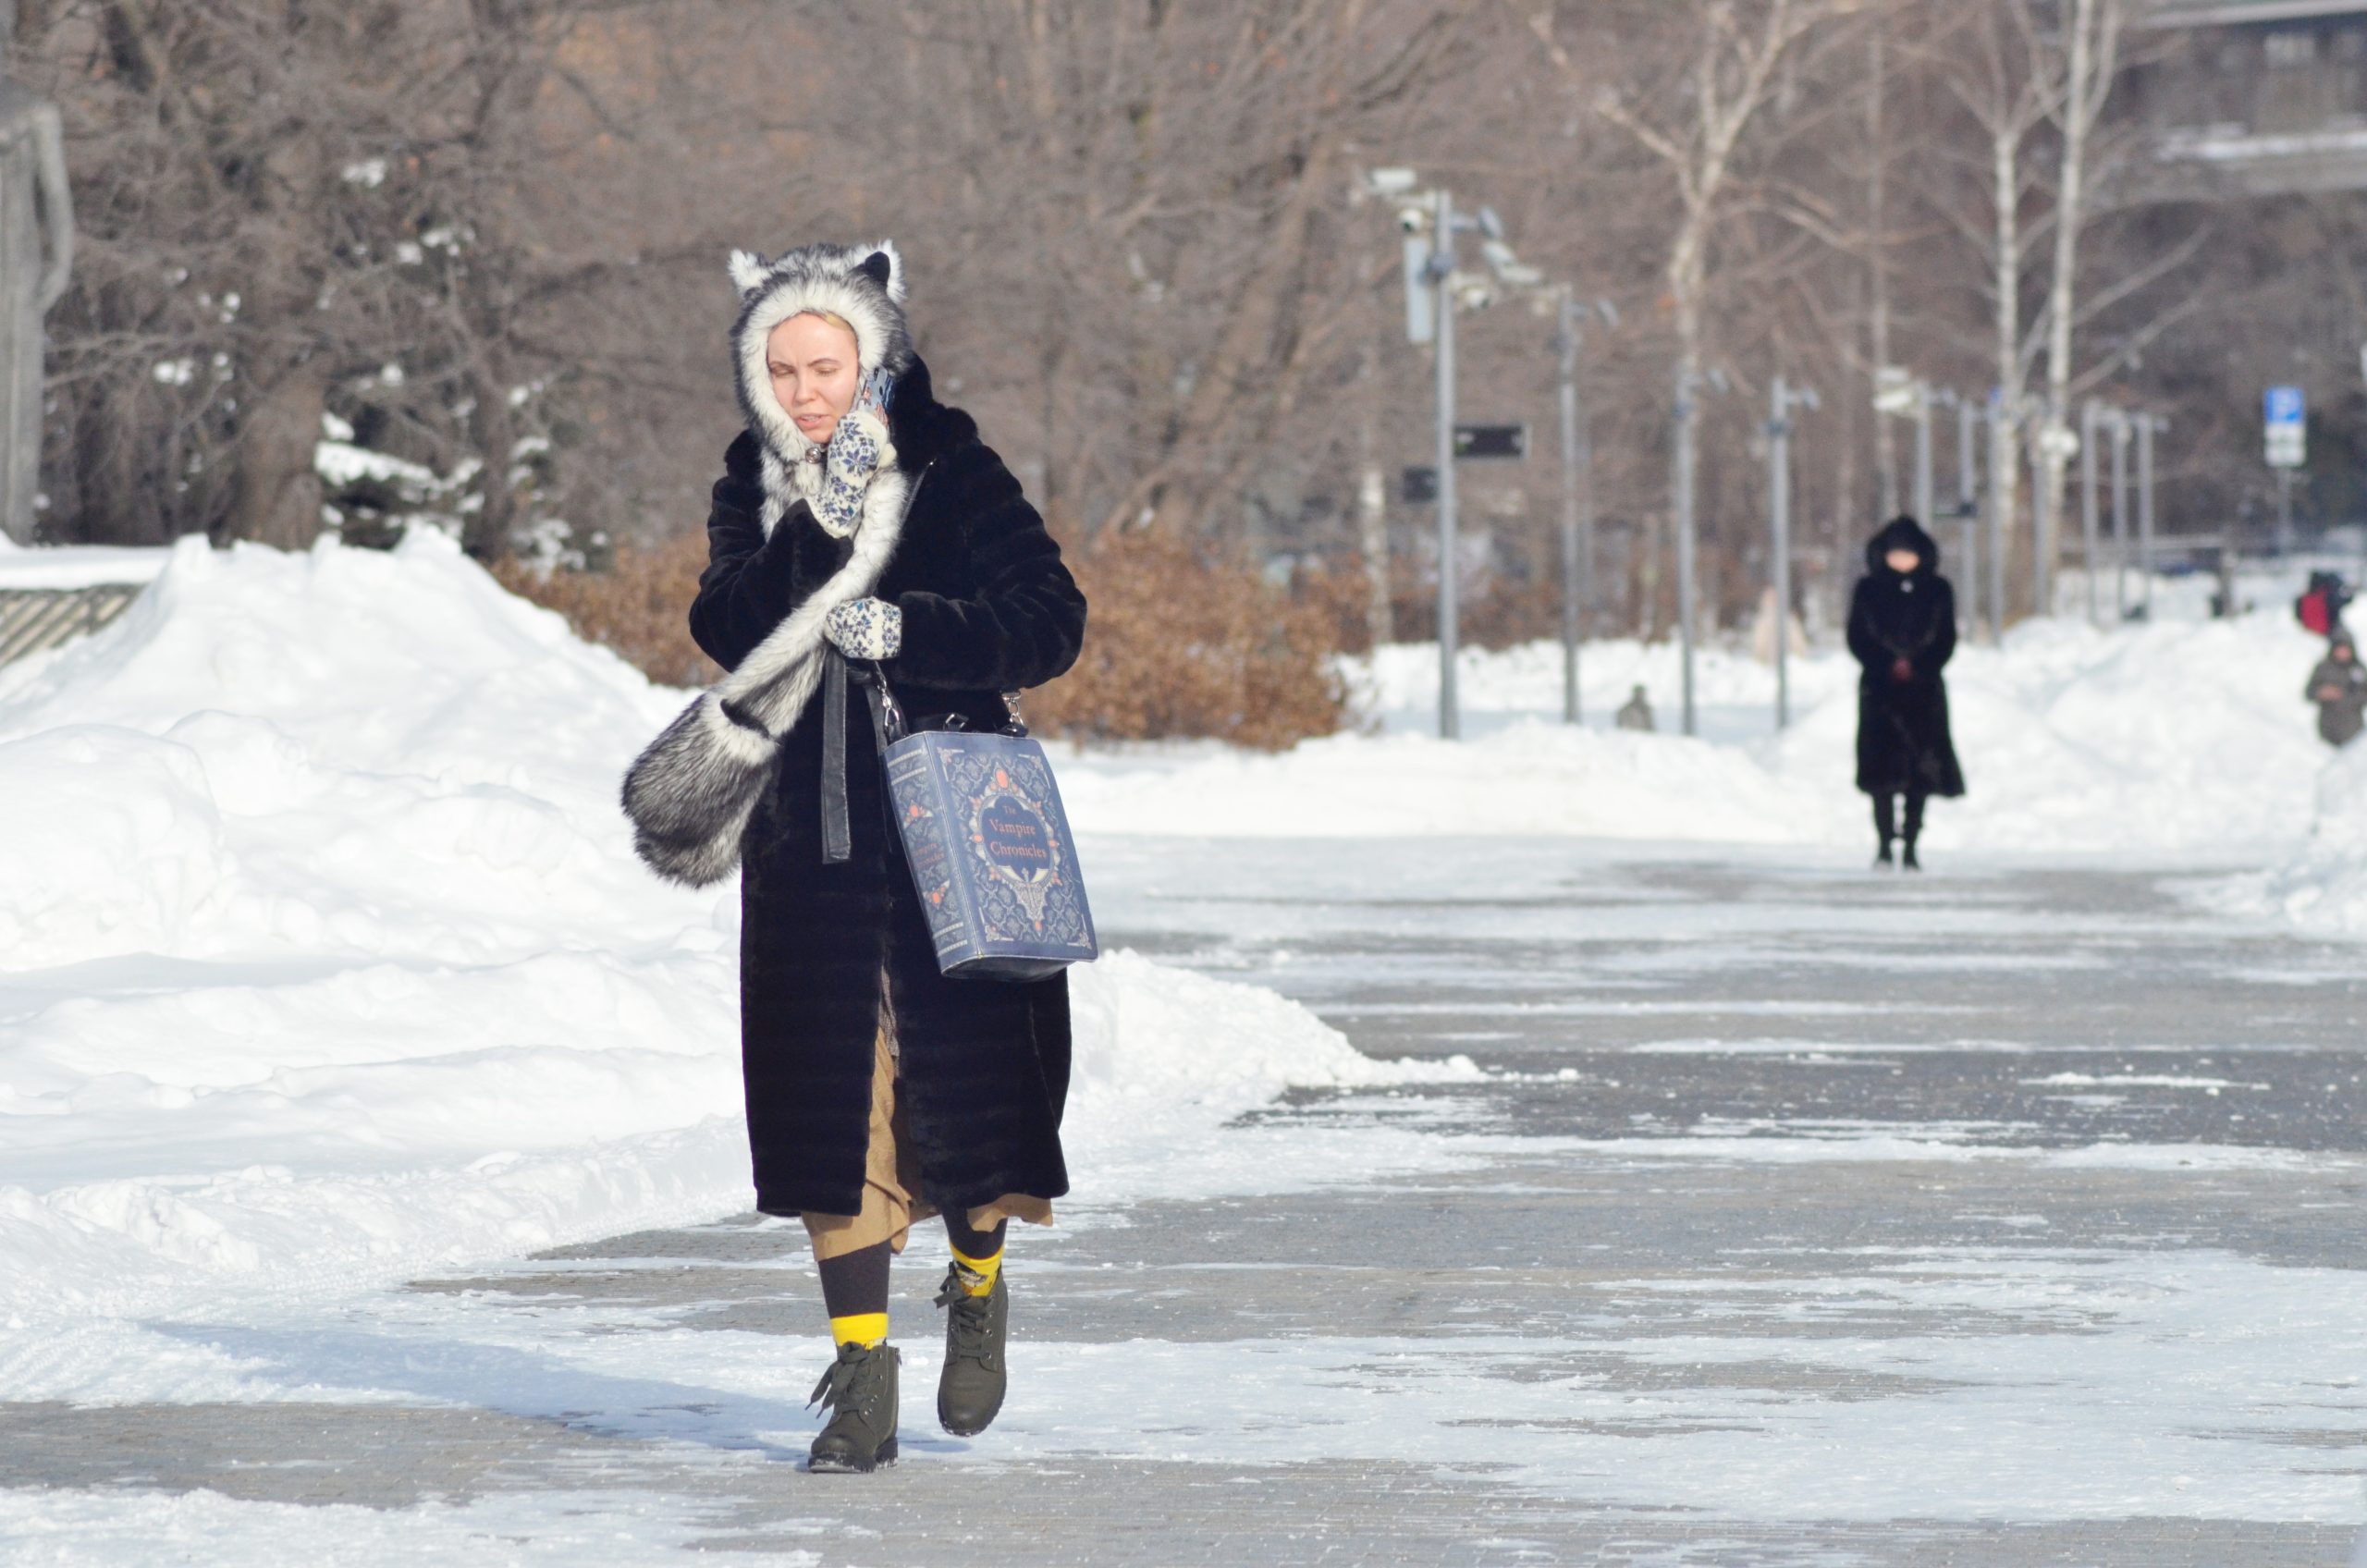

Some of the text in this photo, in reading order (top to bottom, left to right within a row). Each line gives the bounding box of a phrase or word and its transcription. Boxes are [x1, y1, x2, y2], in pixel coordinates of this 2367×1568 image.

[1003, 805, 1016, 815] The
[989, 818, 1036, 839] Vampire
[990, 840, 1047, 858] Chronicles
